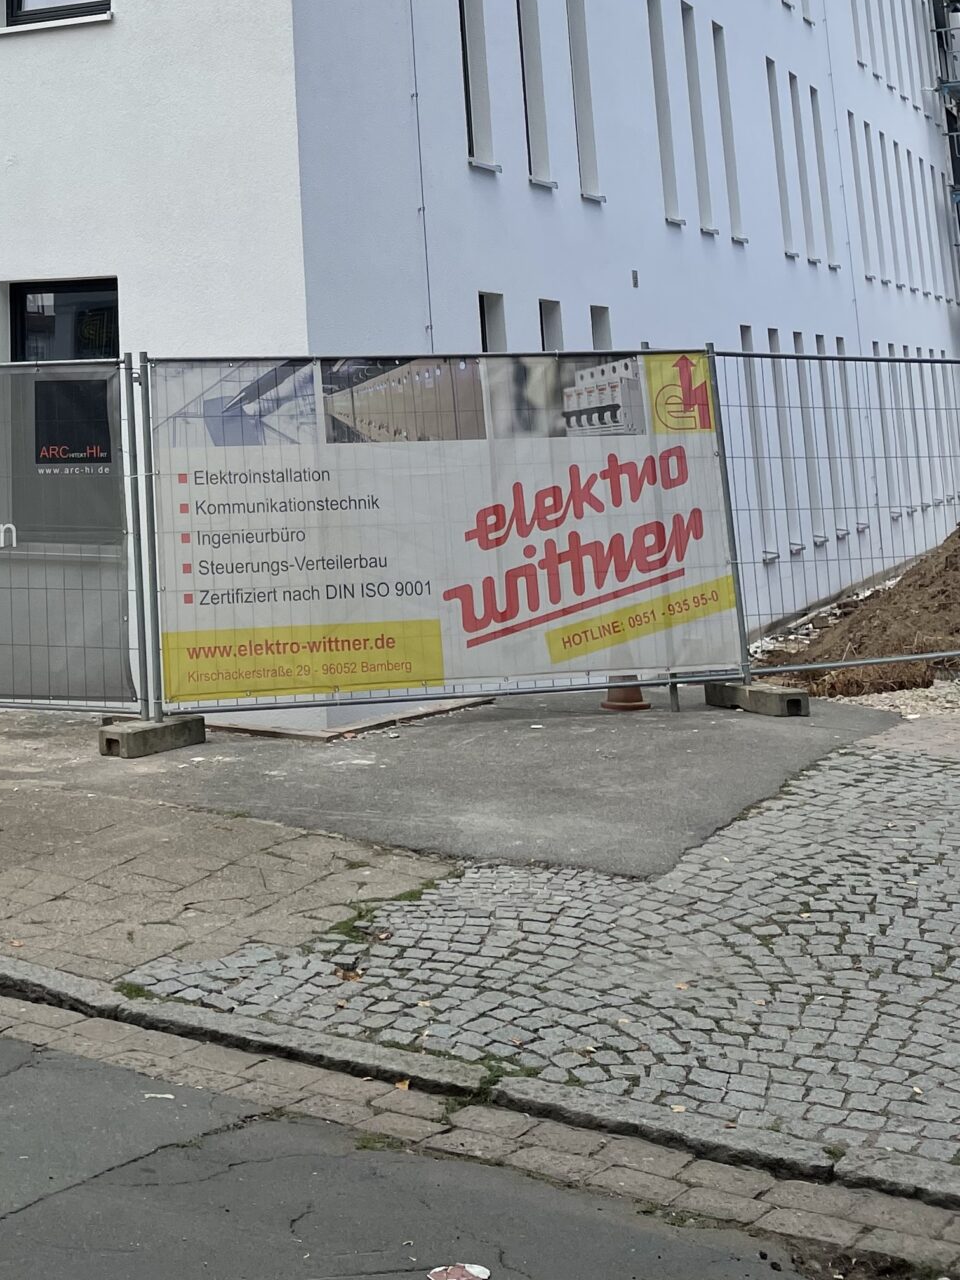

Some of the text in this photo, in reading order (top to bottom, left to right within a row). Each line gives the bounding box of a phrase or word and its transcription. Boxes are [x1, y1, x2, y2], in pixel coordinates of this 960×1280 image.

[37, 465, 110, 475] www.arc-hide
[194, 467, 331, 486] Elektroinstallation
[195, 495, 380, 516] Kommunikationstechnik
[464, 444, 689, 551] elektro
[197, 527, 306, 549] Ingenieurbüro
[198, 554, 388, 577] Steuerungs-Verteilerbau
[442, 507, 704, 633] wittner
[199, 580, 432, 606] Zertifiziert nach DIN ISO 9001
[561, 621, 625, 650] HOTLINE:
[628, 609, 657, 629] 0951
[667, 599, 690, 616] 935
[692, 590, 719, 609] 95-0
[187, 633, 396, 660] www.elektro-wittner.de
[296, 664, 311, 677] 29
[322, 662, 357, 675] 96052
[361, 659, 412, 674] Bamberg
